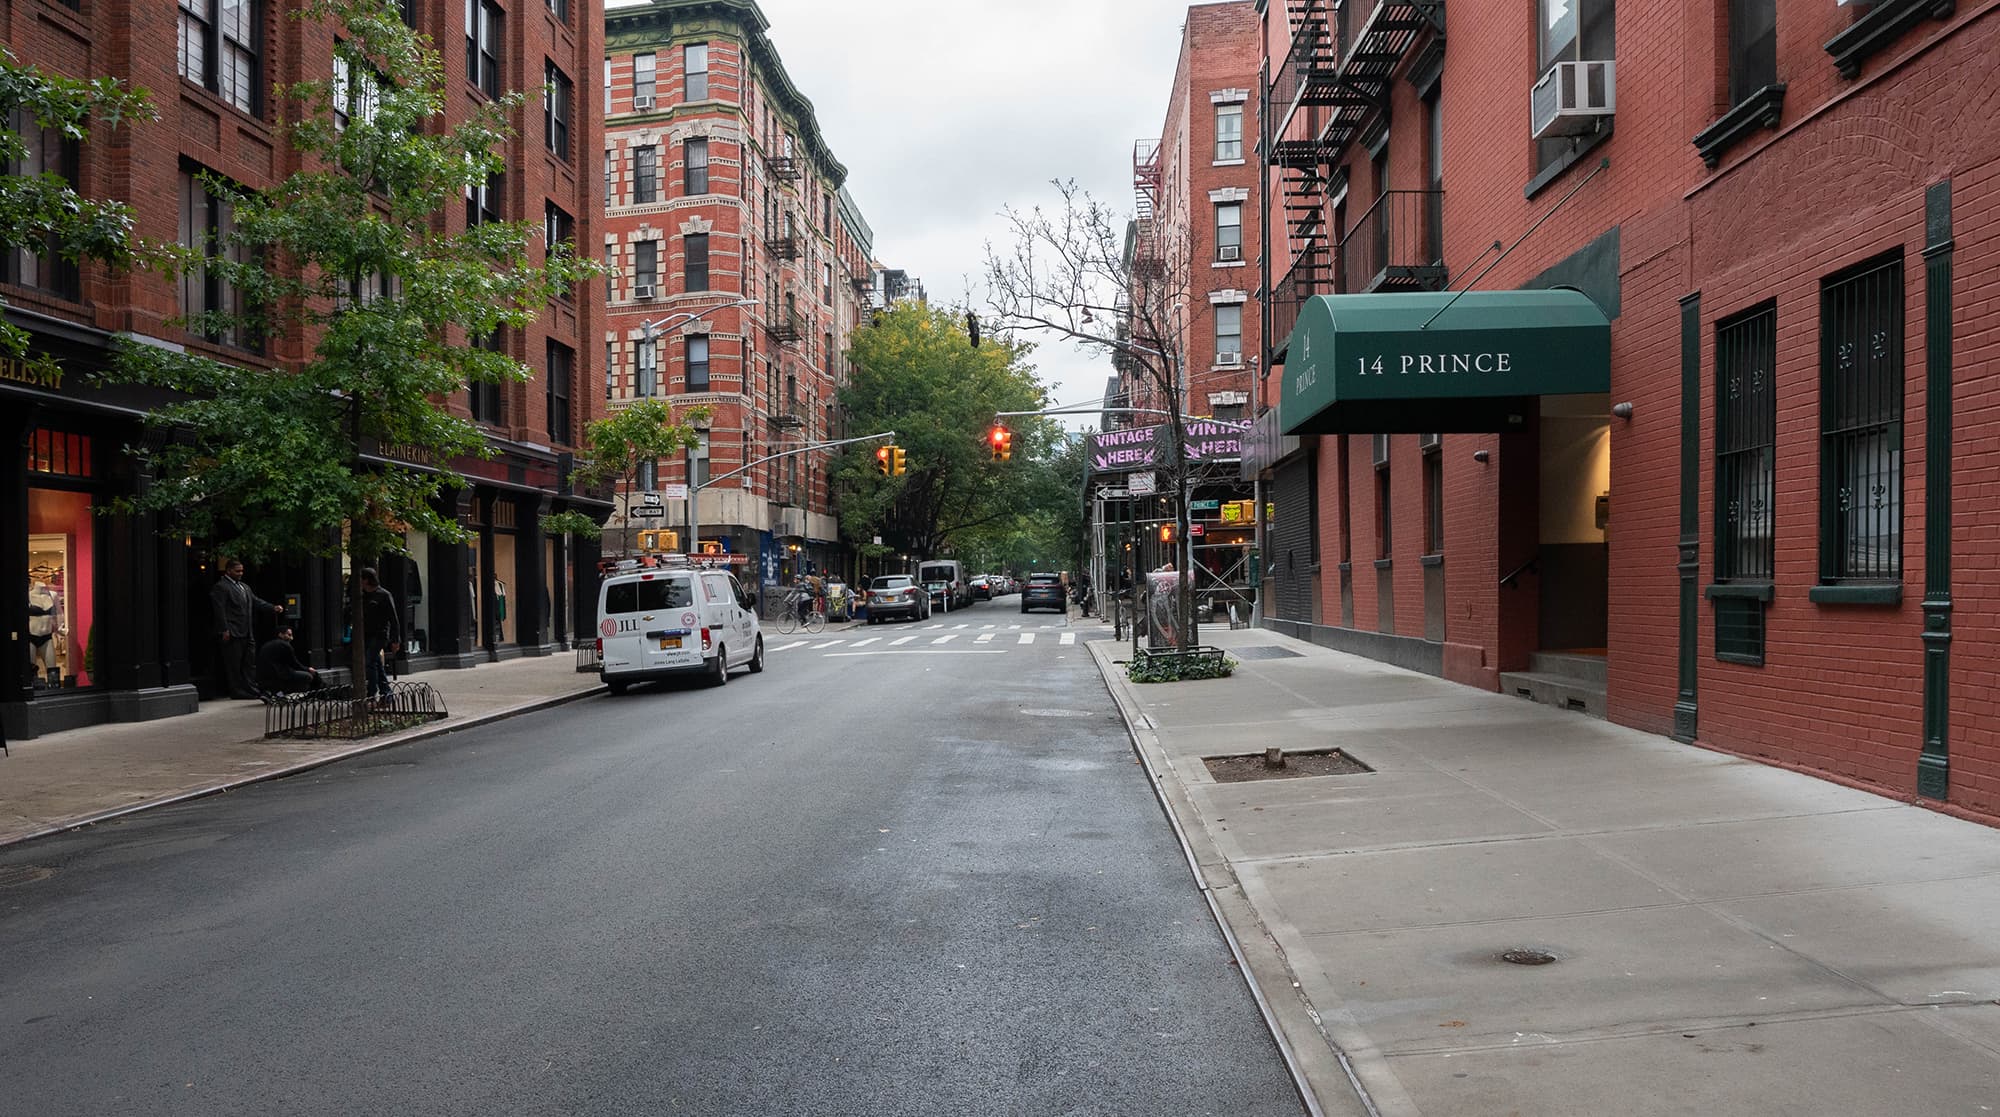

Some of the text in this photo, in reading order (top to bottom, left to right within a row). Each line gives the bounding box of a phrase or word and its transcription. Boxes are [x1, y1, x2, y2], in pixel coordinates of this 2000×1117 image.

[1303, 327, 1311, 362] 14
[1358, 352, 1511, 375] 14 PRINCE
[1295, 363, 1316, 396] PRINCE
[1096, 428, 1154, 448] VINTAGE
[1107, 448, 1143, 464] HERE
[618, 618, 640, 632] JLL
